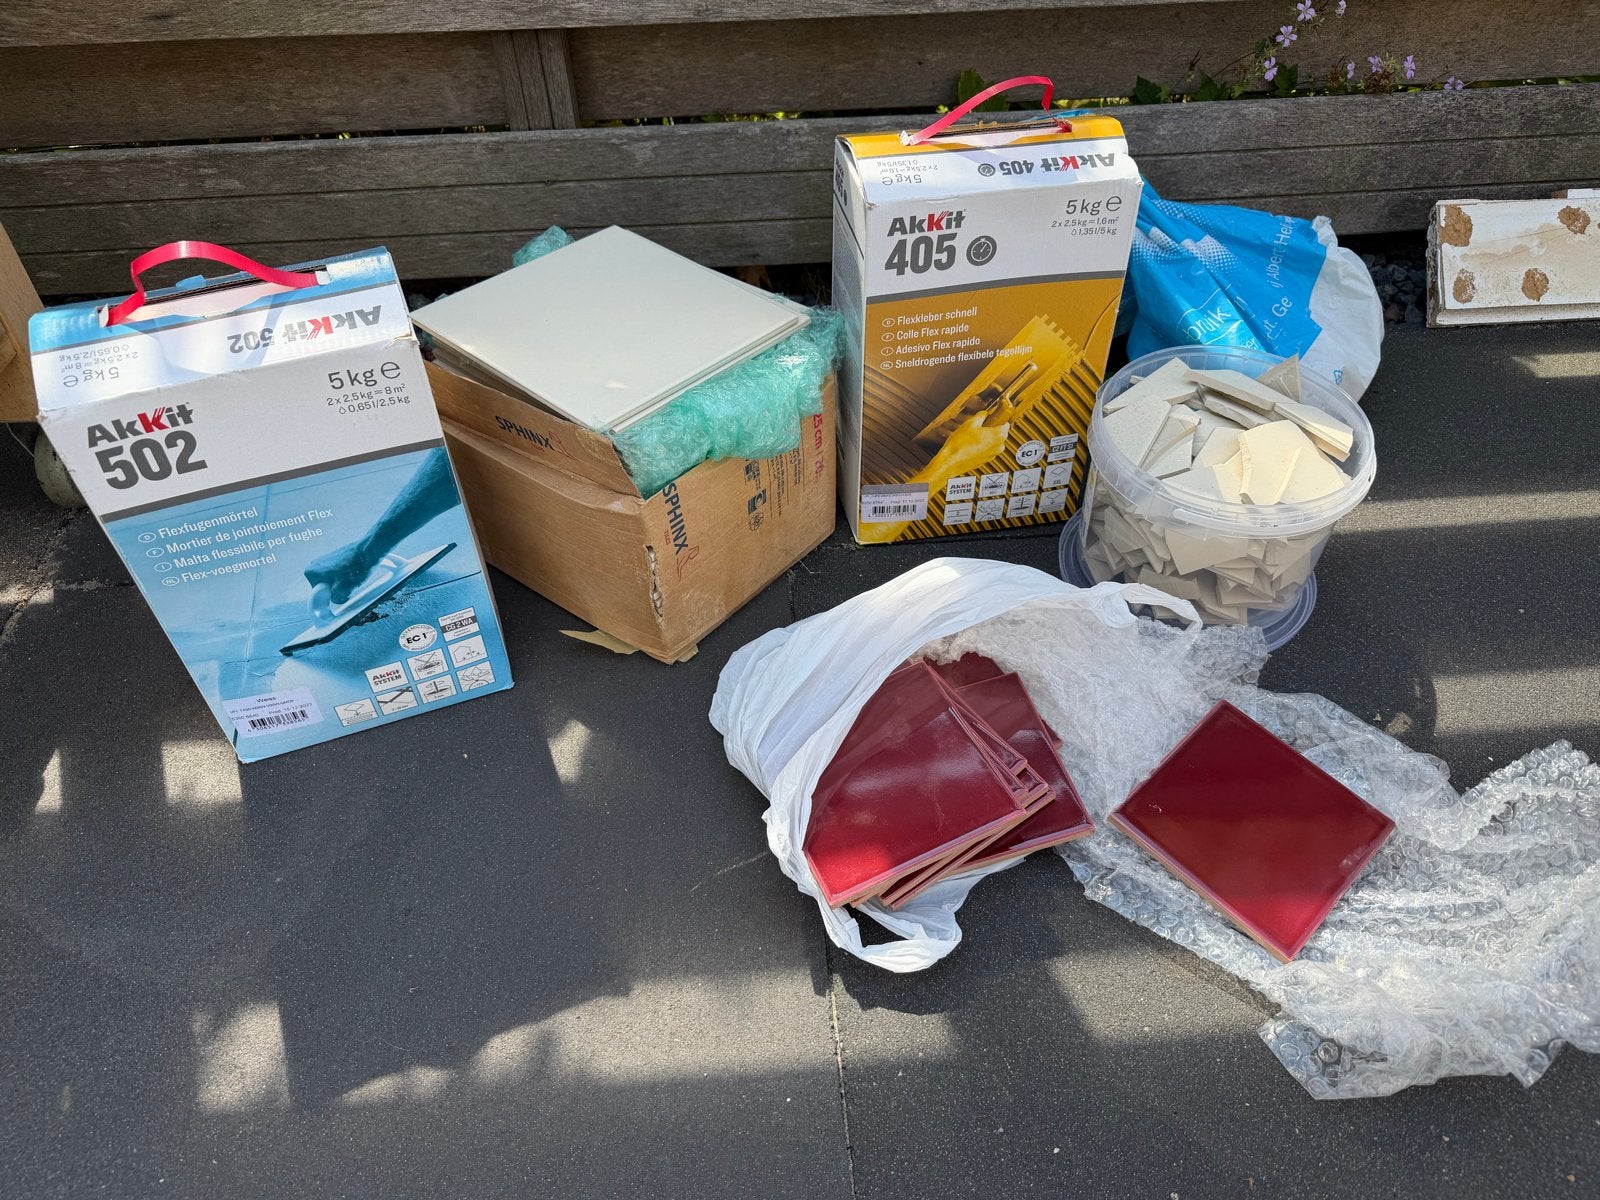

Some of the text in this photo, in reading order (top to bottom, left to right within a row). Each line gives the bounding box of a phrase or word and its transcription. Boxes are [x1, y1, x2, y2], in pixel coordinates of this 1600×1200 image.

[998, 153, 1115, 176] AkKit 405
[887, 208, 966, 237] AkKit
[885, 232, 957, 277] 405
[1265, 247, 1286, 281] Albert
[227, 305, 382, 354] AkKit 502
[897, 312, 943, 326] Flexkleber
[945, 306, 978, 320] schnell
[895, 343, 931, 355] Adesivo
[932, 340, 951, 351] Flex
[952, 336, 981, 350] rapido
[896, 328, 919, 341] Colle
[921, 327, 939, 338] Flex
[941, 323, 969, 338] rapide
[895, 354, 956, 370] Sneldrogende
[957, 349, 994, 363] flexibele
[996, 344, 1033, 360] tegellijm
[87, 402, 194, 449] AkKit
[495, 415, 555, 451] SPHINX
[95, 430, 208, 490] 502
[1021, 450, 1033, 458] EC
[949, 487, 972, 496] SYSTEM
[157, 506, 259, 540] Flexfugenmörtel
[166, 537, 213, 555] Mortier
[215, 531, 231, 543] de
[231, 515, 306, 541] jointoiement
[308, 507, 333, 521] Flex
[661, 481, 689, 555] SPHINX
[173, 554, 211, 570] Malta
[211, 541, 265, 560] flessibile
[267, 536, 286, 551] per
[287, 526, 323, 544] fughe
[181, 553, 277, 583] Flex-voegmortel
[406, 635, 421, 645] EC
[372, 669, 400, 681] AkKit
[373, 674, 402, 687] SYSTEM
